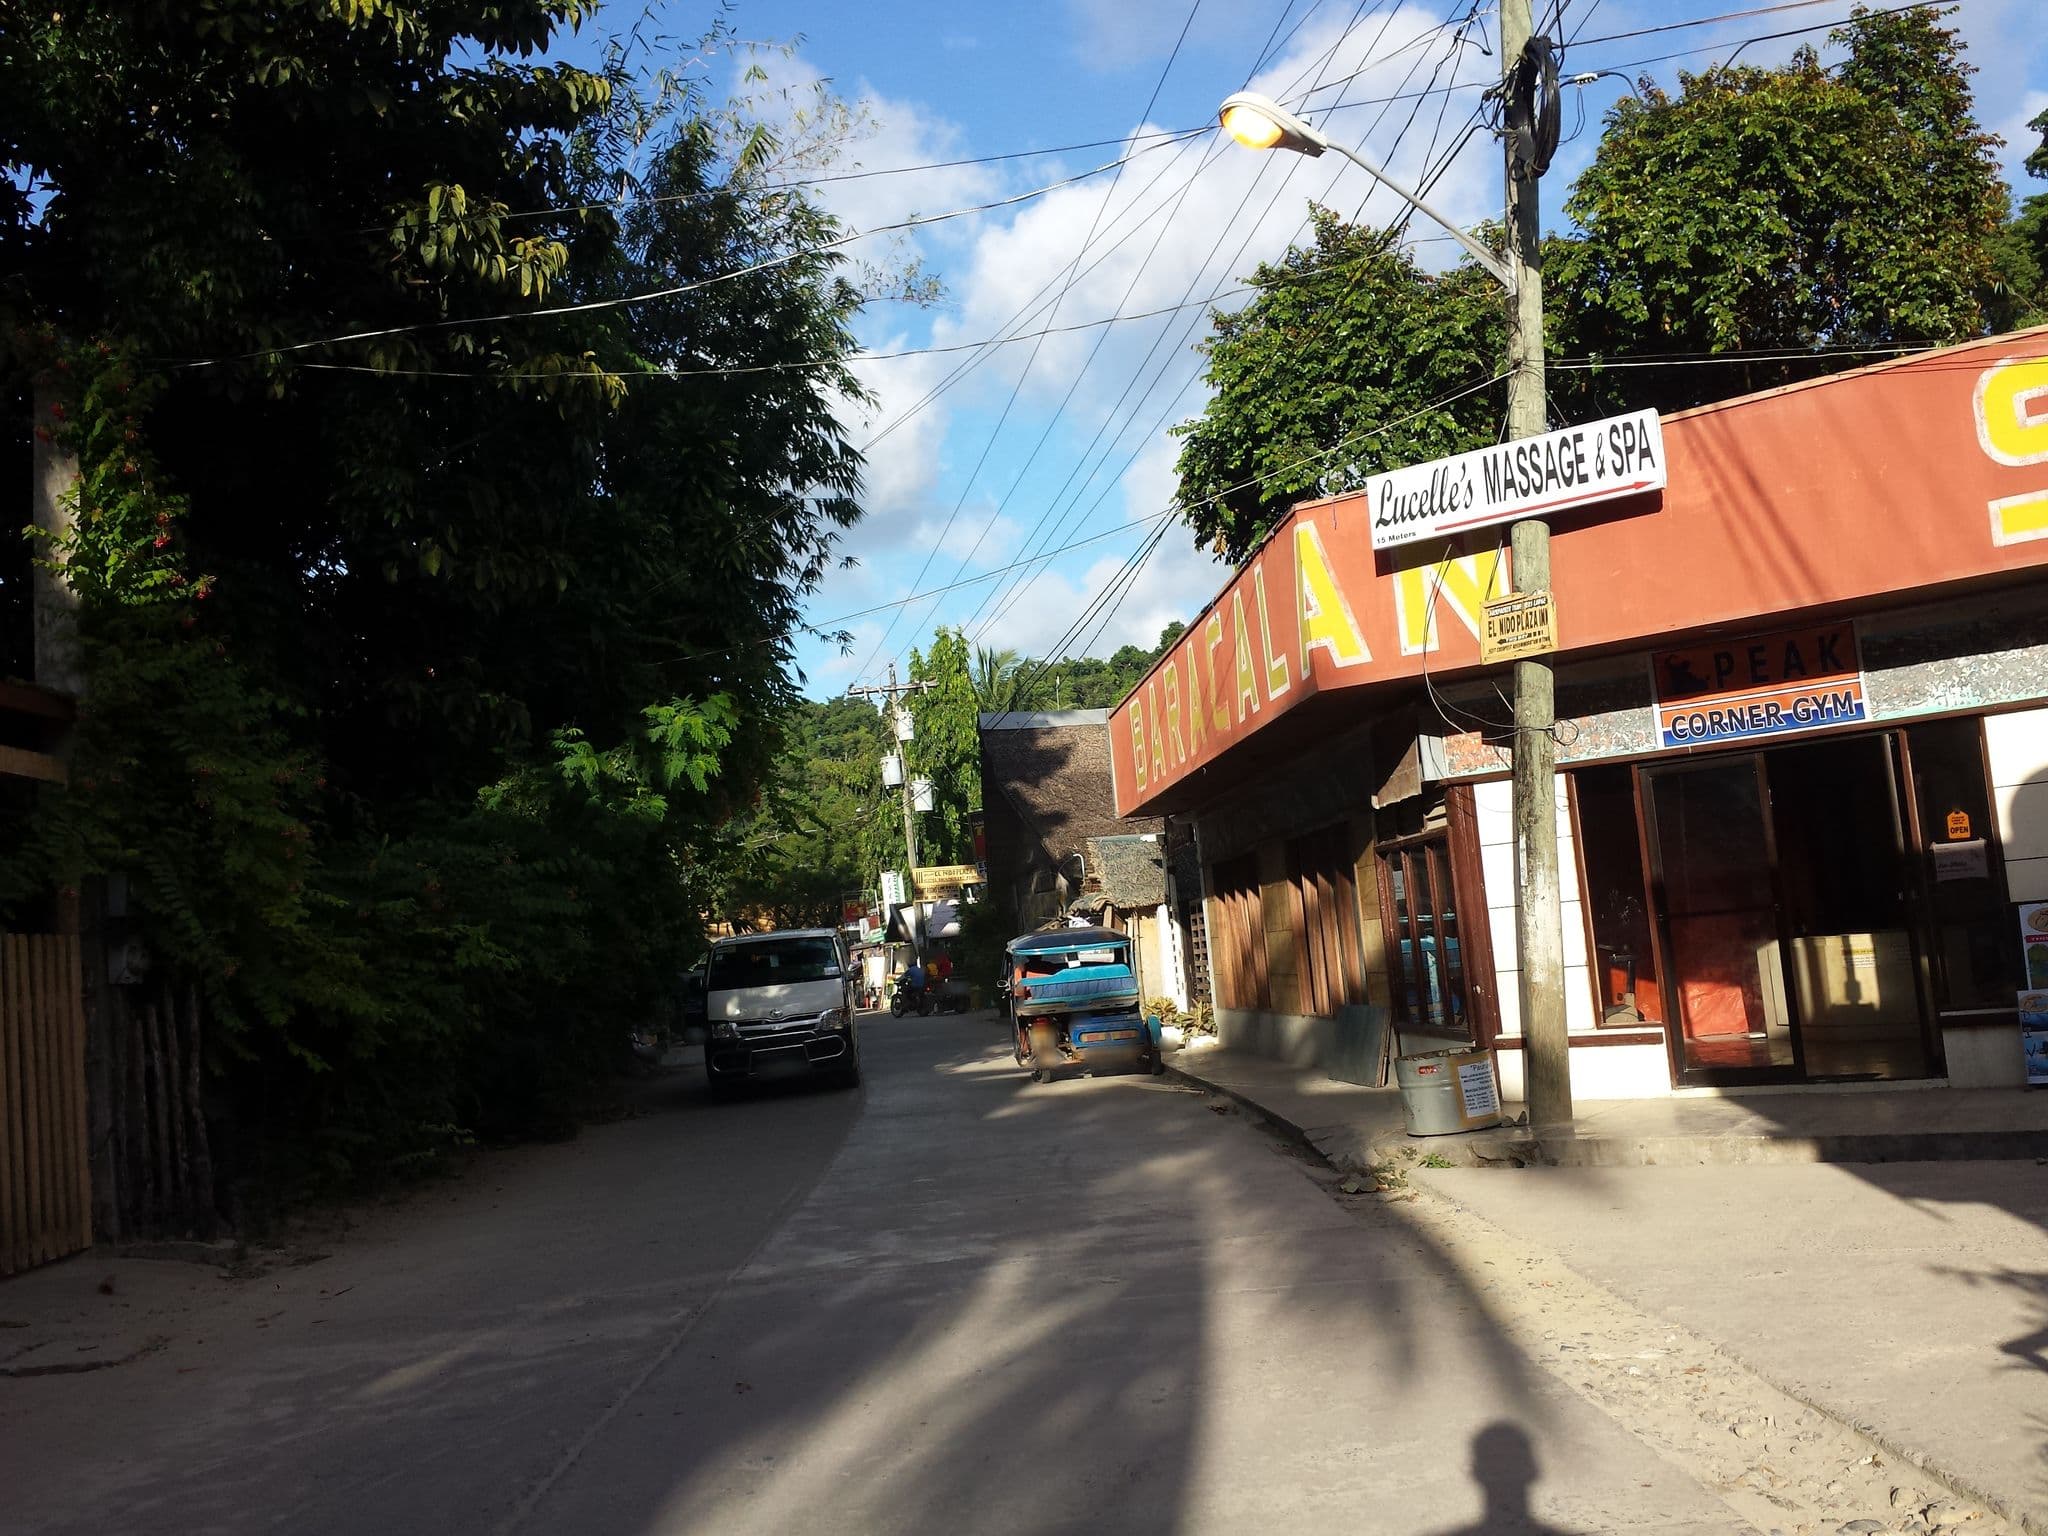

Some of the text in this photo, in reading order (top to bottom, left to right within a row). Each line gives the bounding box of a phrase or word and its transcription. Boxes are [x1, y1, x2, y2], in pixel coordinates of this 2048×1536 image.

[1375, 418, 1655, 529] Lucelle's MASSAGE & SPA
[1376, 531, 1417, 545] 15 Meters
[1488, 620, 1497, 638] EL
[1499, 616, 1515, 636] NIDO
[1516, 610, 1538, 632] PLAZA
[1714, 634, 1845, 688] PEAK
[1671, 690, 1856, 741] CORNER GYM
[1950, 826, 1969, 834] OPEN
